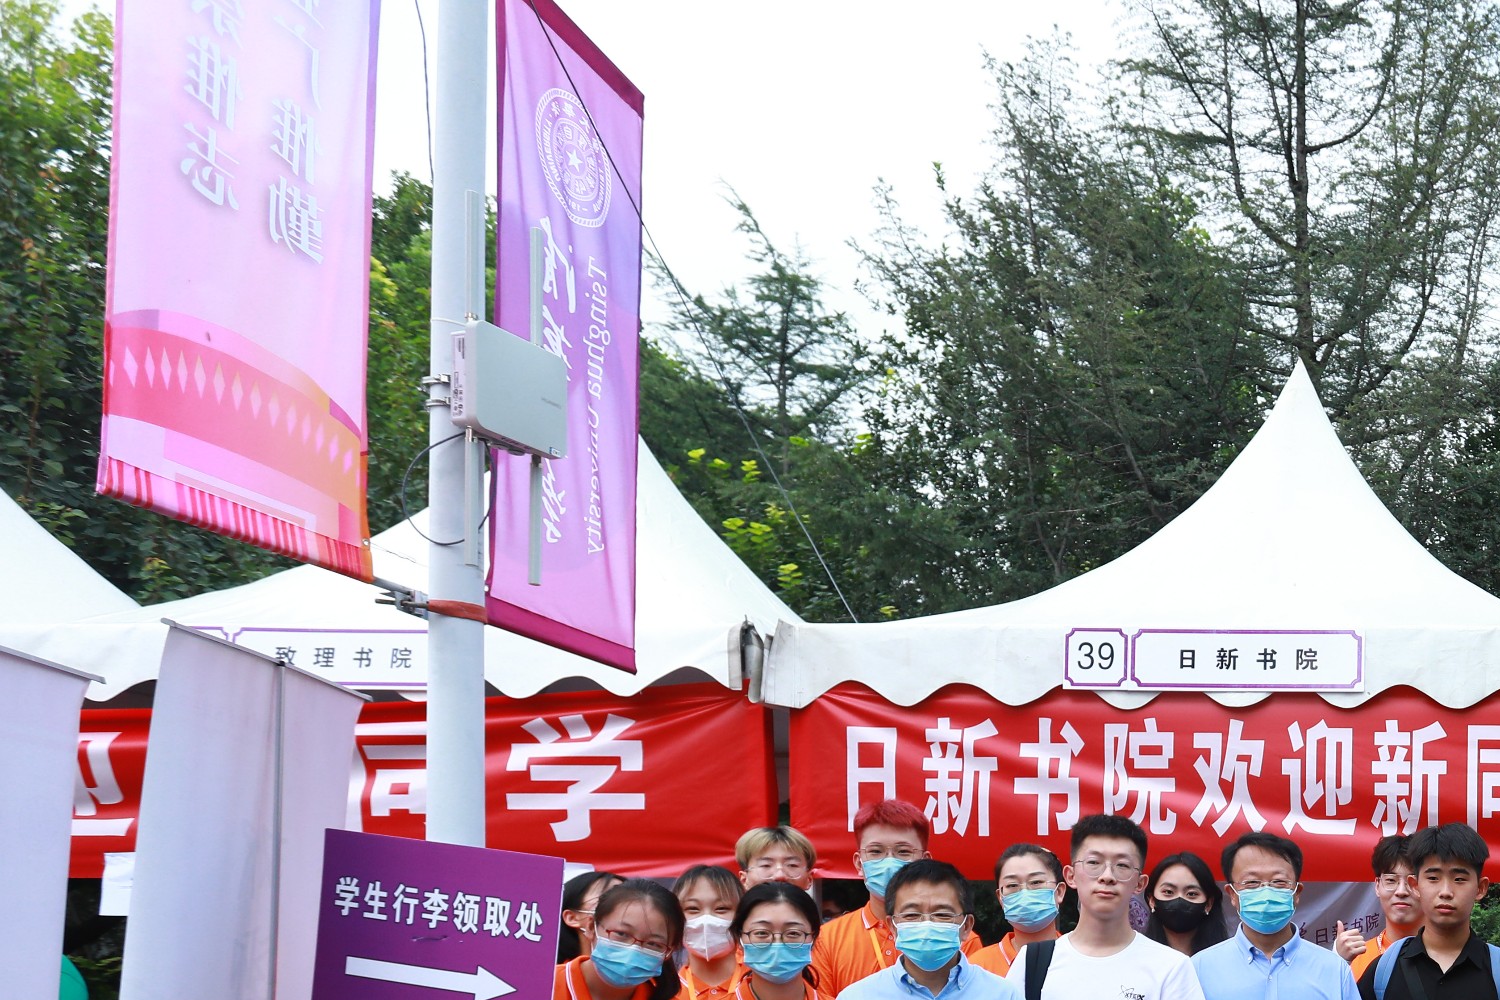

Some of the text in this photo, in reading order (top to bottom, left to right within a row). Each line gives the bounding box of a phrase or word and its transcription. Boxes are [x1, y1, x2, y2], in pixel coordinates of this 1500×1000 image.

[275, 645, 413, 670] 致理书院
[1076, 642, 1116, 672] 39
[1179, 646, 1320, 672] 日新书院
[334, 876, 544, 944] 学生行李领取处
